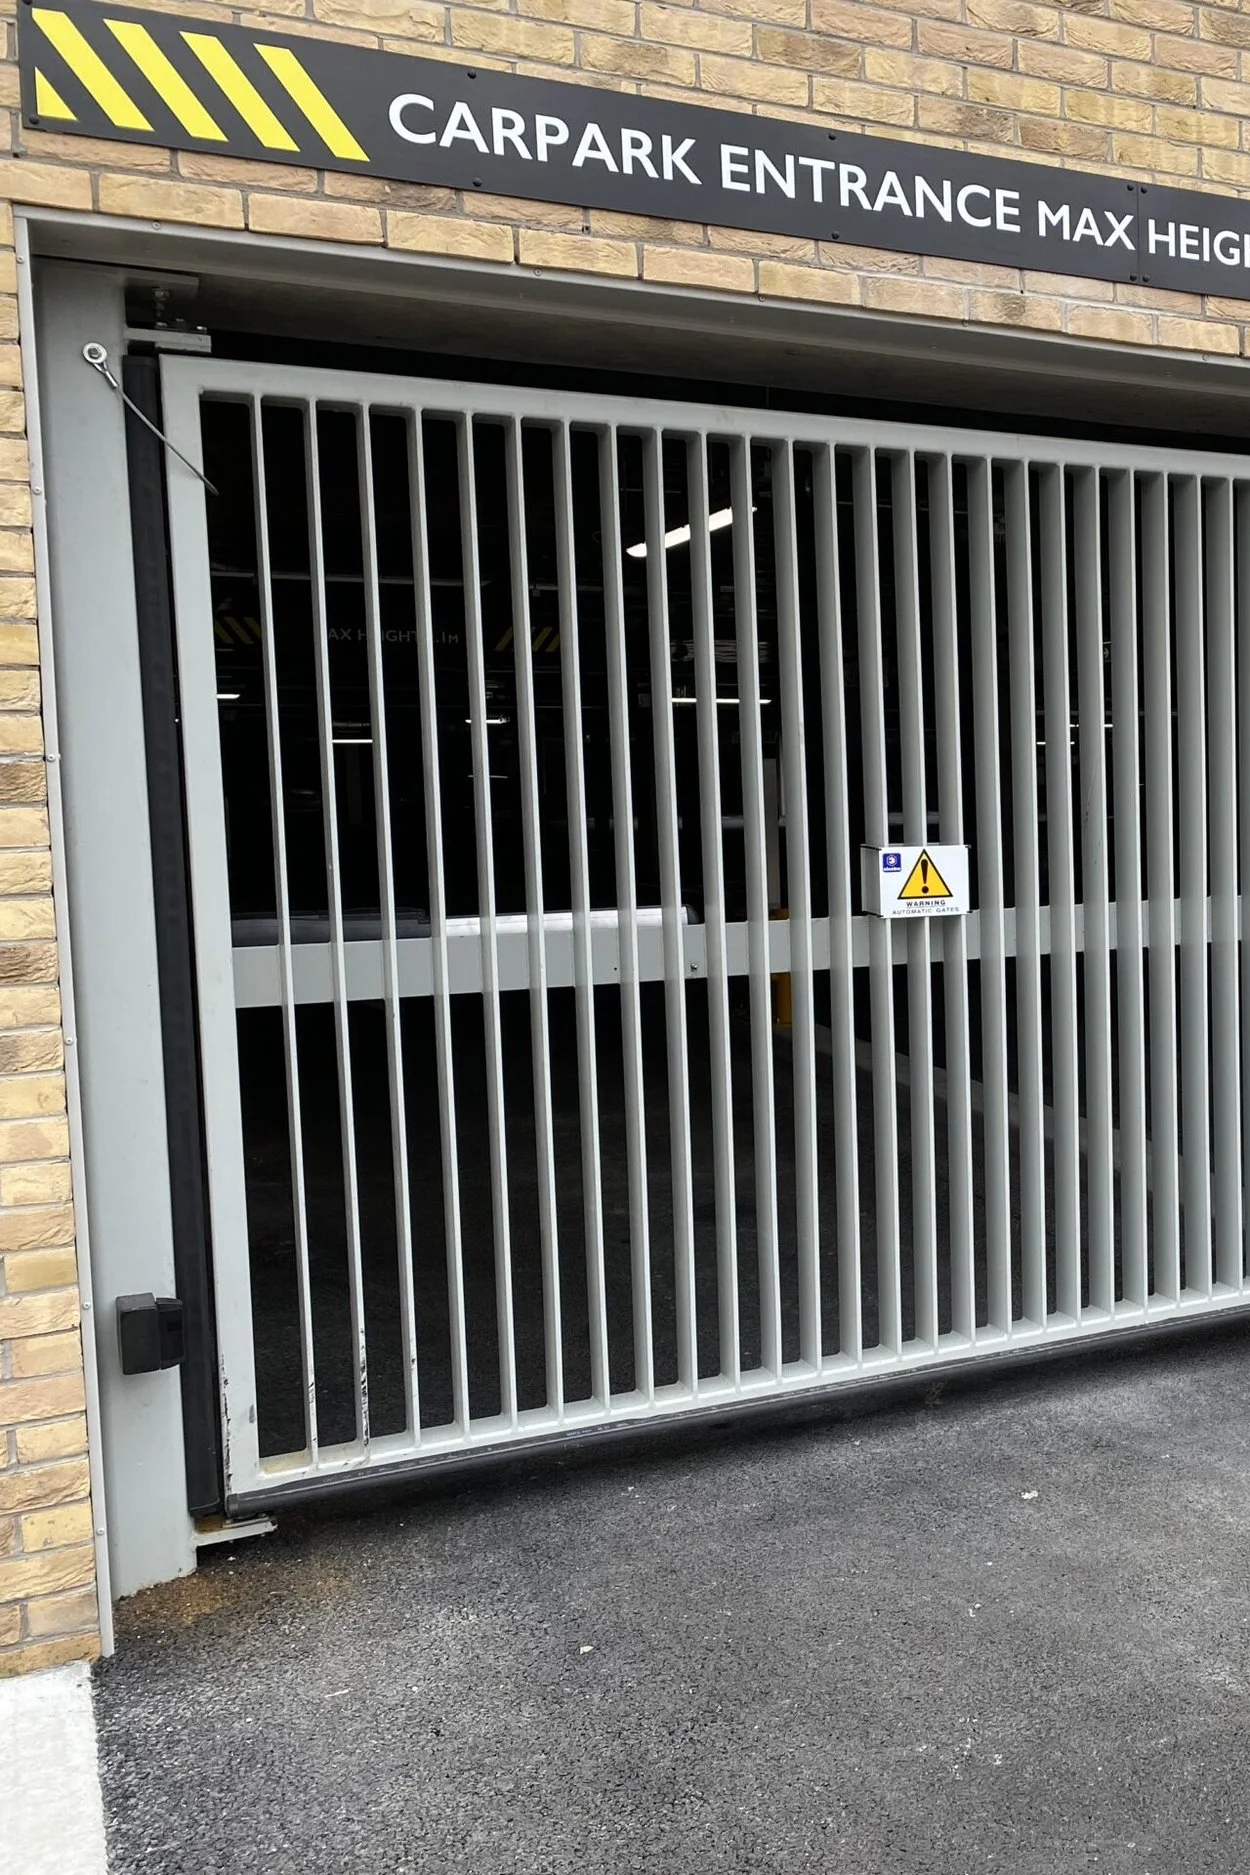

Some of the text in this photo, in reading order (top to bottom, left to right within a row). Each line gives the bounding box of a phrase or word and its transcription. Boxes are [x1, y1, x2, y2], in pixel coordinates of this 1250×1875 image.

[387, 93, 703, 185] CARPARK
[719, 143, 1021, 233] ENTRANCE
[1037, 199, 1137, 251] MAX
[357, 627, 417, 643] HIGHT
